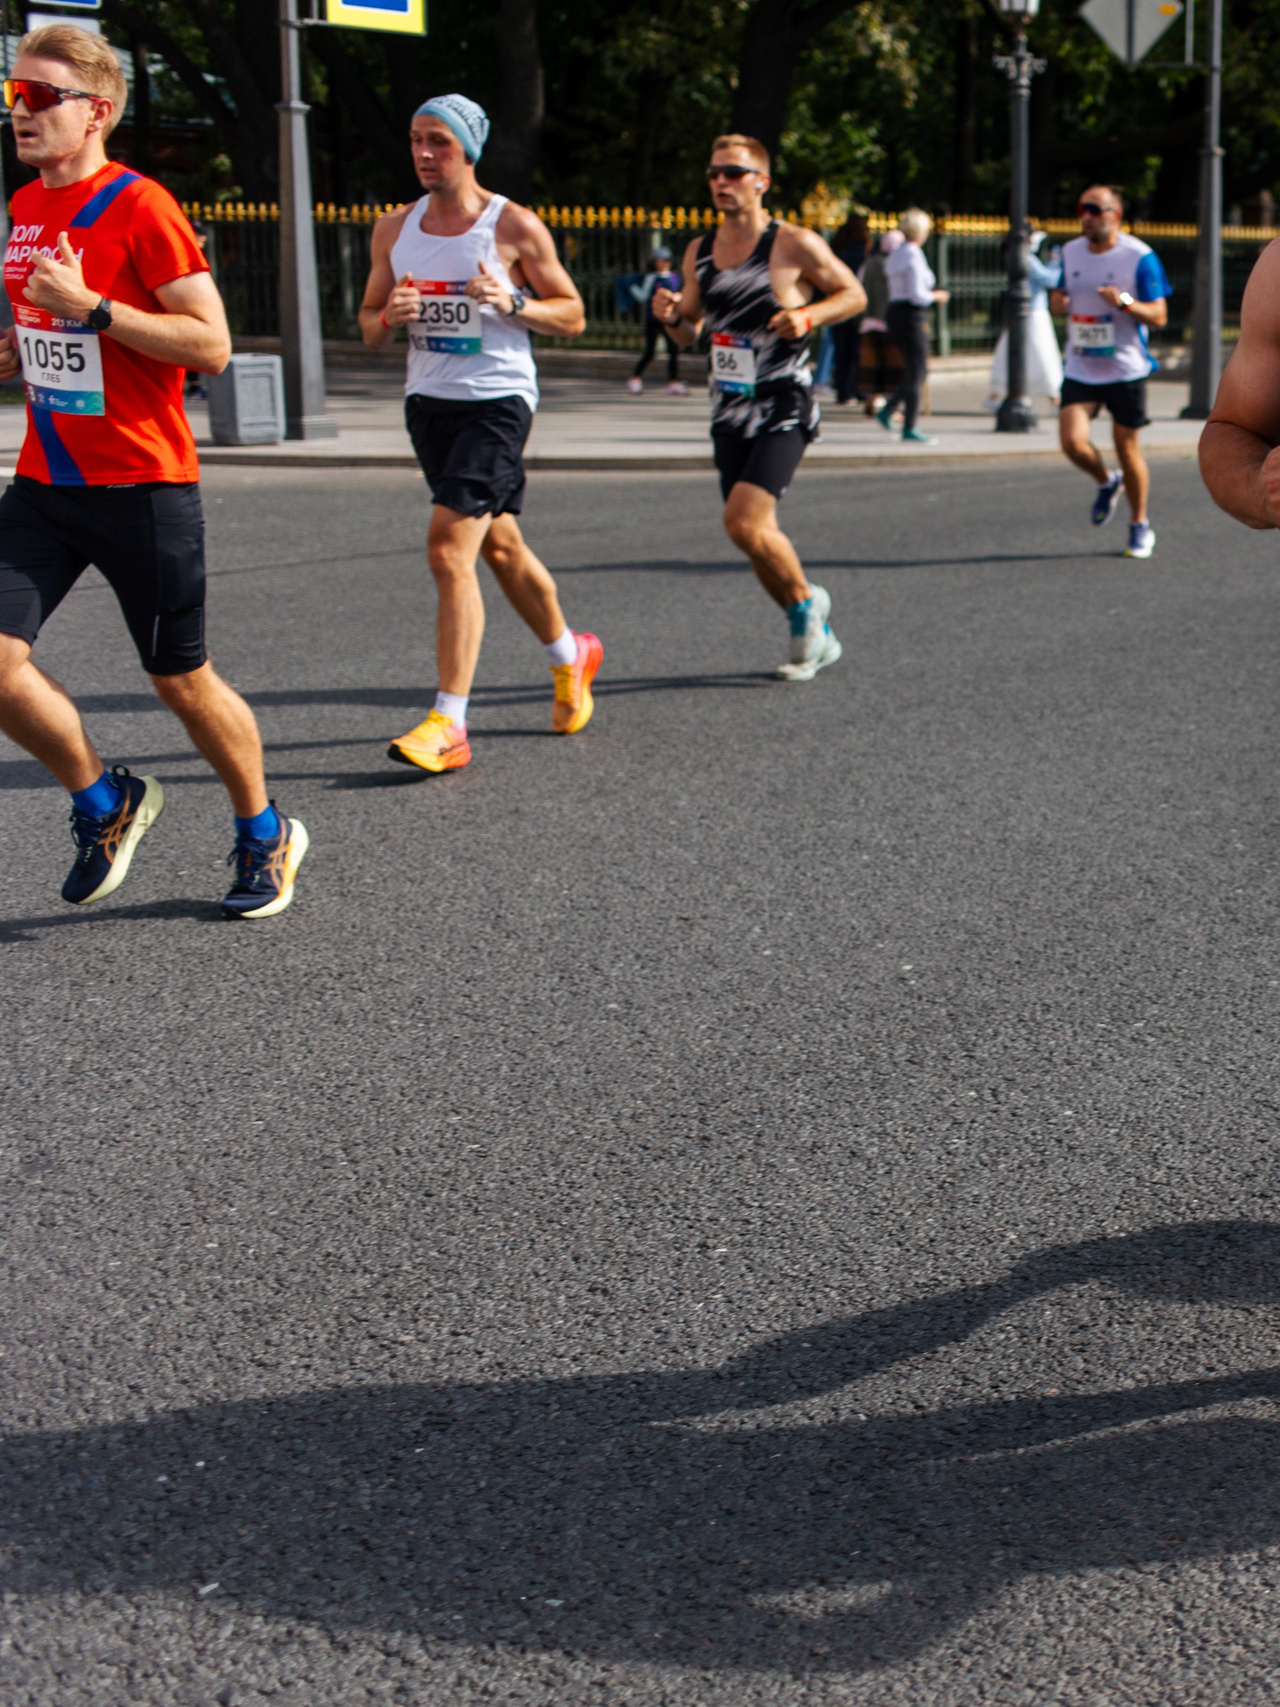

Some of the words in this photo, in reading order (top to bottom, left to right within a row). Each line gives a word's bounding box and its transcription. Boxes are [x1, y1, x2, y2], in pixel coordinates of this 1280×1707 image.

[417, 301, 470, 324] 2350
[23, 336, 86, 373] 1055
[716, 351, 737, 370] 86
[41, 372, 61, 383] ГЛЕБ
